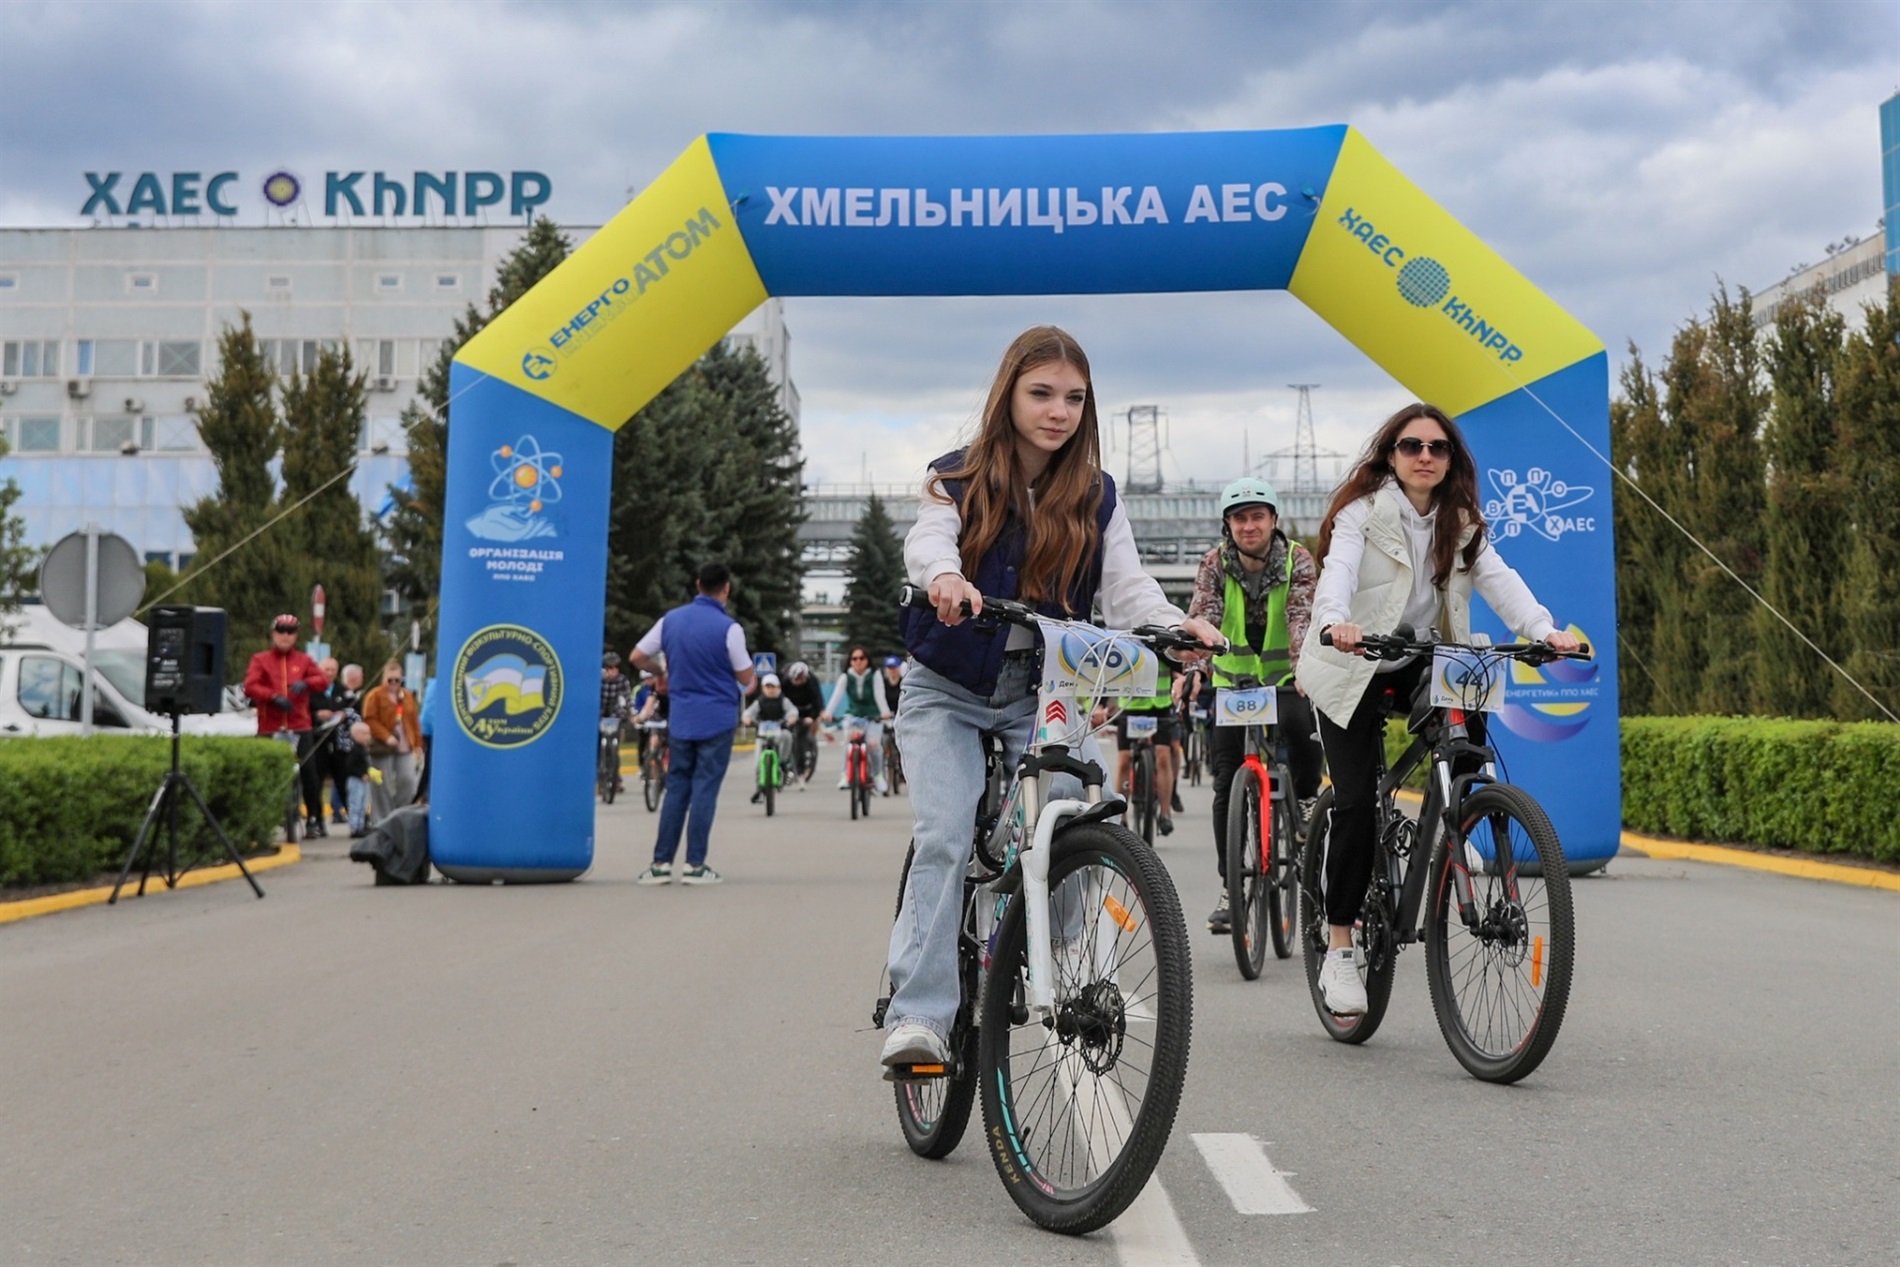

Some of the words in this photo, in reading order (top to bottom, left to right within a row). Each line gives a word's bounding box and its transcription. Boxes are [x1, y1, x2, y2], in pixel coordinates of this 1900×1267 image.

[80, 171, 239, 216] ХАЕС
[324, 171, 553, 216] KhNPP
[764, 184, 1169, 233] ХМЕЛЬНИЦЬКА
[1183, 182, 1288, 223] АЕС
[1338, 207, 1405, 268] ХАЕС
[469, 547, 564, 560] ОРГАНІЗАЦІЯ
[486, 560, 544, 573] МОЛОДІ
[1236, 700, 1256, 712] 88
[992, 1126, 1021, 1184] KENDA
